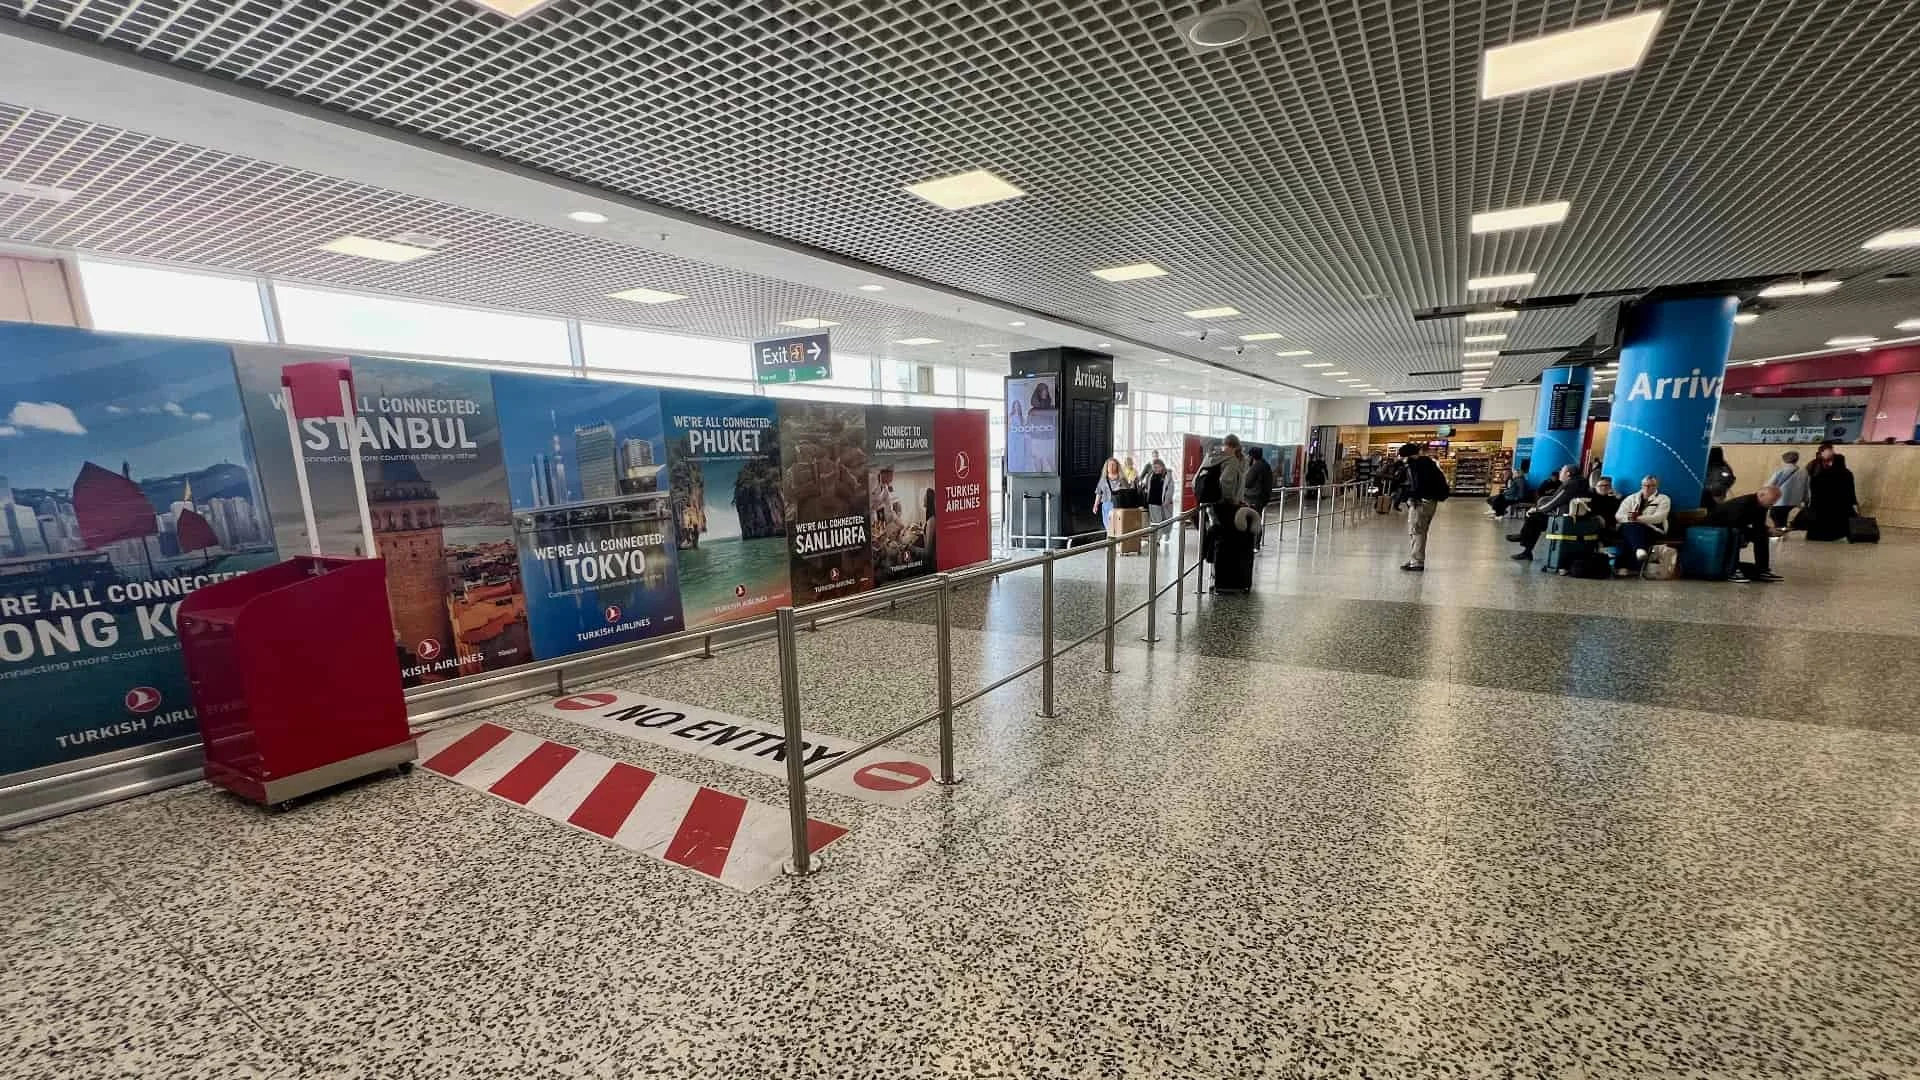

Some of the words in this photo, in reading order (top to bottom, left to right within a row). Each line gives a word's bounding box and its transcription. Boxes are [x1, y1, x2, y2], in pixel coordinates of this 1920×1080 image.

[762, 345, 788, 365] Exit
[1074, 365, 1107, 389] Arrivals
[355, 396, 375, 413] LL
[379, 397, 481, 415] CONNECTED:
[1377, 403, 1472, 421] WHSmith
[303, 415, 478, 450] STANBUL
[673, 416, 703, 428] WE'RE
[705, 416, 722, 428] ALL
[689, 430, 761, 454] PHUKET
[945, 483, 980, 498] TURKISH
[945, 496, 981, 513] AIRLINES
[817, 519, 829, 530] ALL
[534, 543, 574, 560] WE'RE
[577, 541, 598, 556] ALL
[600, 533, 665, 551] CONNECTED:
[795, 525, 867, 554] SANLIURFA
[564, 550, 646, 585] TOKYO
[1, 594, 41, 617] RE
[50, 588, 101, 612] ALL
[107, 570, 249, 604] CONNECT
[0, 611, 119, 662] ONG
[576, 627, 615, 642] TURKISH
[616, 618, 651, 633] AIRLINES
[0, 662, 70, 681] onnecting
[402, 663, 431, 679] KISH
[434, 652, 484, 671] AIRLINES
[603, 704, 686, 729] NO
[56, 717, 147, 749] TURKISH
